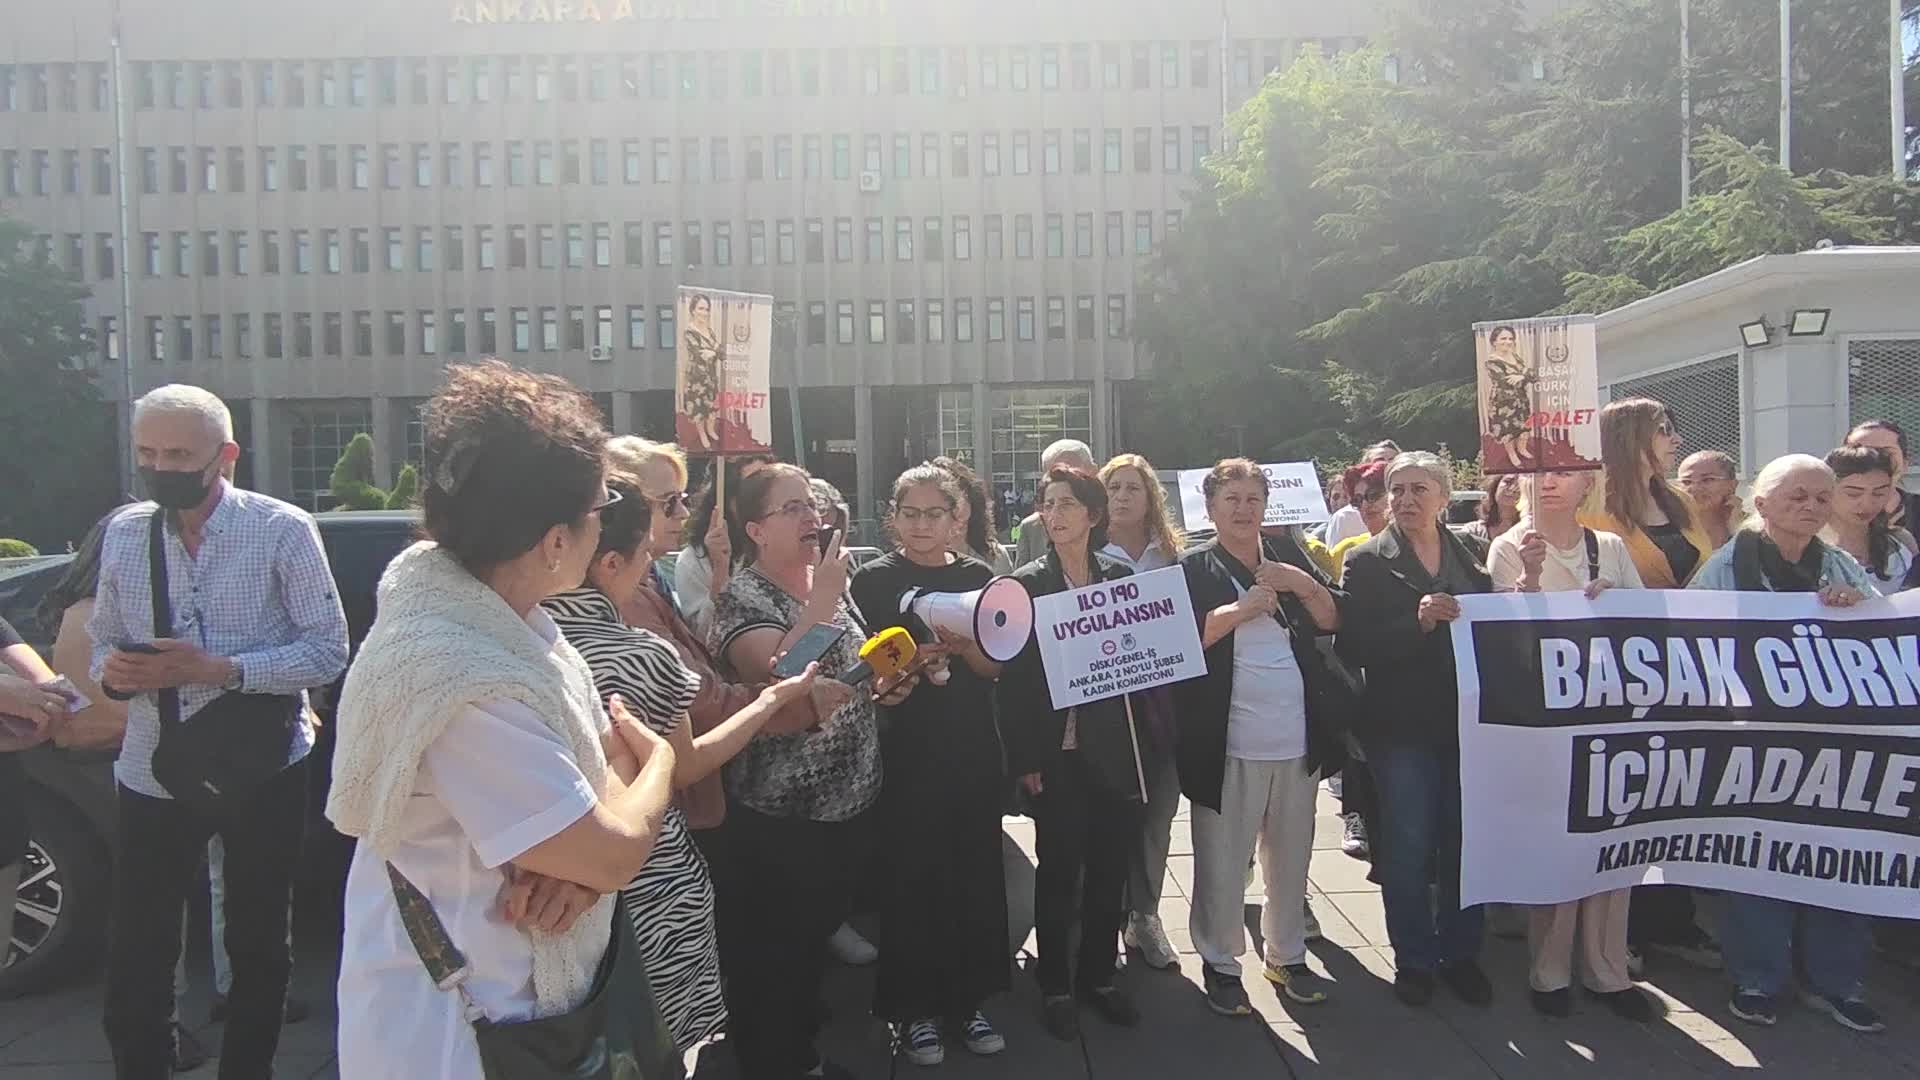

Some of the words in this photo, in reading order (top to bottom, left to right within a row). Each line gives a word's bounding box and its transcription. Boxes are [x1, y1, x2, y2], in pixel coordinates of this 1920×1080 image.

[1524, 409, 1596, 427] ADALET
[1076, 590, 1107, 612] ILO
[1110, 582, 1140, 604] 190
[1052, 598, 1175, 641] UYGULANSIN!
[1068, 671, 1112, 689] ANKARA
[1114, 668, 1122, 678] 2
[1123, 659, 1152, 675] NO'LU
[1152, 652, 1185, 671] ŞUBESİ
[1089, 648, 1157, 672] DİSK/GENEL-İŞ
[1539, 636, 1752, 719] BAŞAK
[1082, 682, 1115, 698] KADIN
[1116, 668, 1175, 691] KOMİSYONU
[1587, 735, 1706, 826] İÇİN
[1712, 746, 1920, 819] ADALE
[1596, 831, 1762, 874] KARDELENLİ
